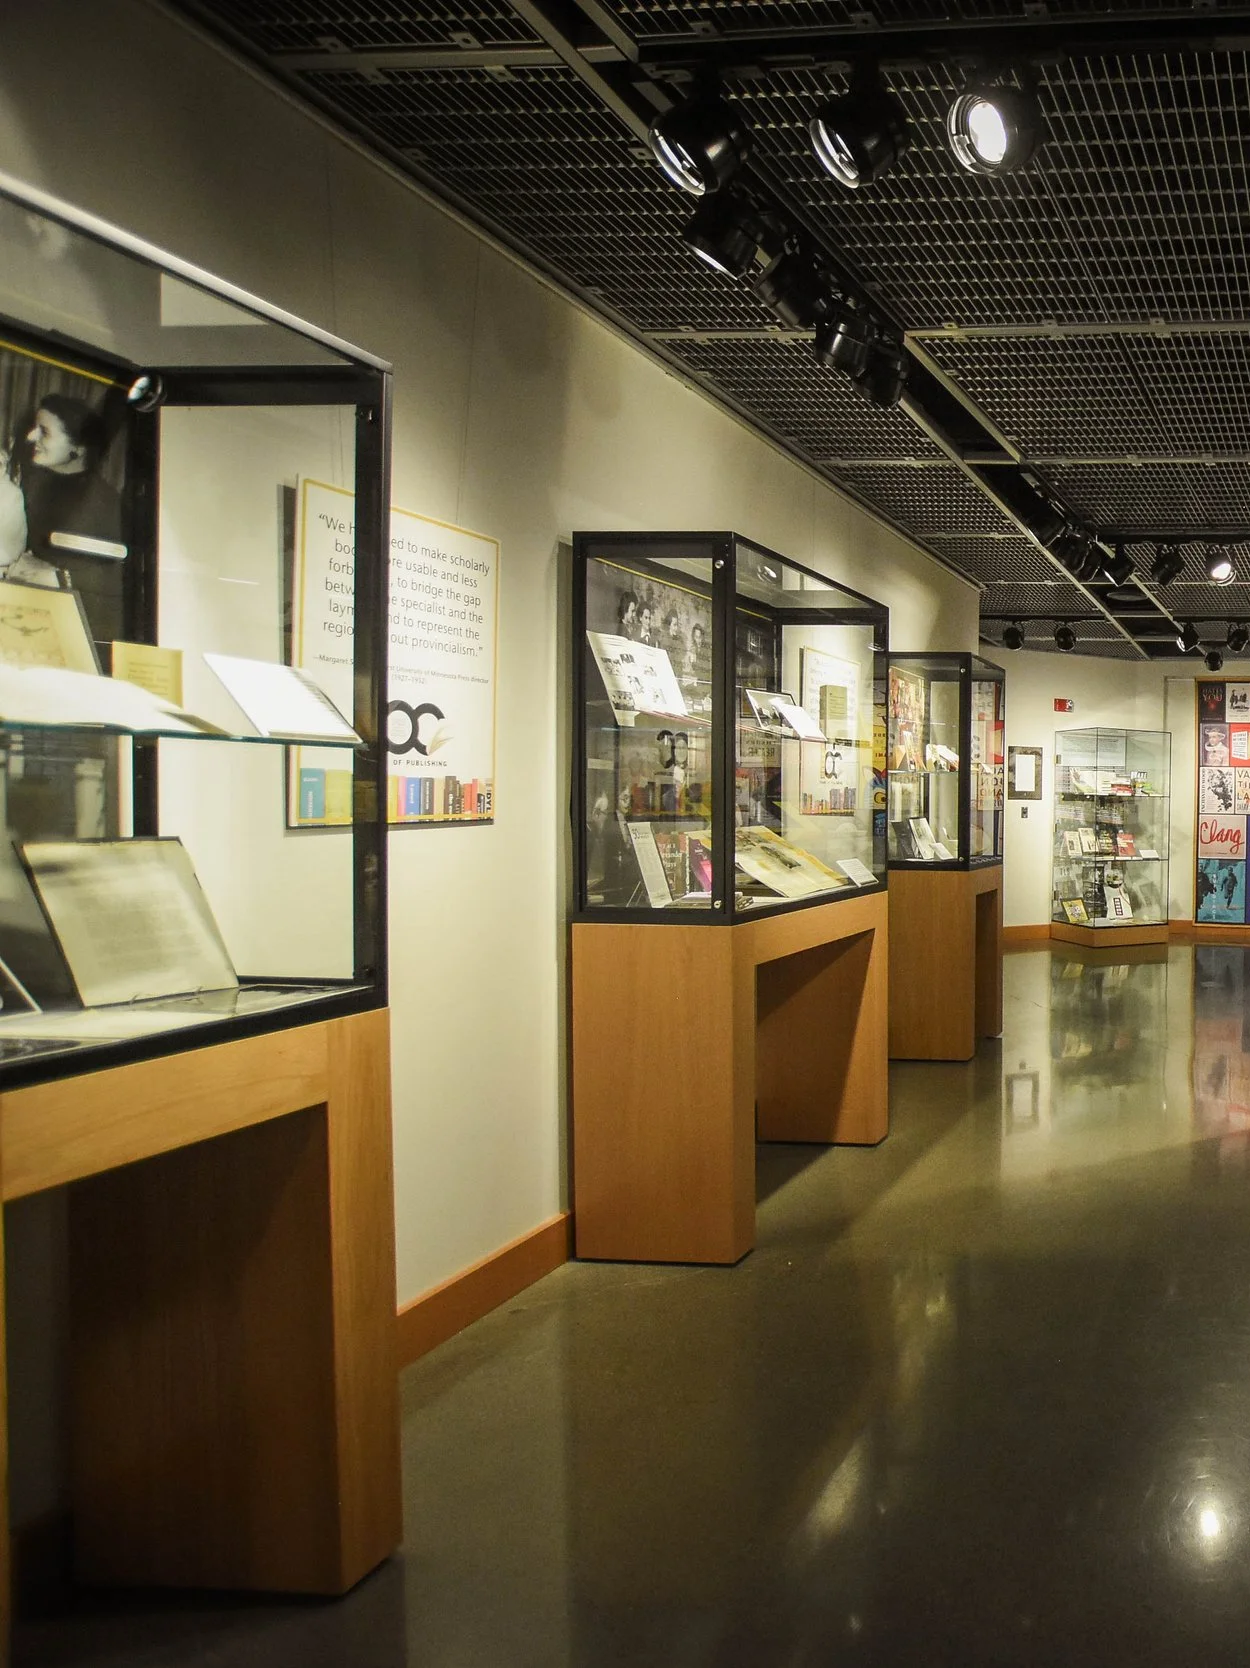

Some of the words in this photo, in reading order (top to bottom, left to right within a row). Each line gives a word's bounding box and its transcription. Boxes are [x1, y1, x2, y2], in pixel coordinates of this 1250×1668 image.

[318, 513, 346, 533] “We
[390, 538, 404, 550] ed
[408, 542, 418, 554] to
[421, 547, 448, 562] make
[450, 554, 490, 577] scholarly
[391, 558, 402, 568] re
[406, 561, 438, 578] usable
[440, 568, 459, 584] and
[461, 573, 478, 588] less
[397, 577, 408, 589] to
[411, 579, 444, 600] bridge
[446, 587, 462, 602] the
[463, 594, 482, 608] gap
[400, 597, 446, 616] specialist
[448, 607, 466, 620] and
[469, 611, 484, 624] the
[403, 616, 414, 628] to
[416, 619, 464, 637] represent
[466, 626, 480, 640] the
[1202, 693, 1222, 702] YOU
[406, 760, 448, 768] PUBLISHING
[1200, 819, 1244, 854] Clang
